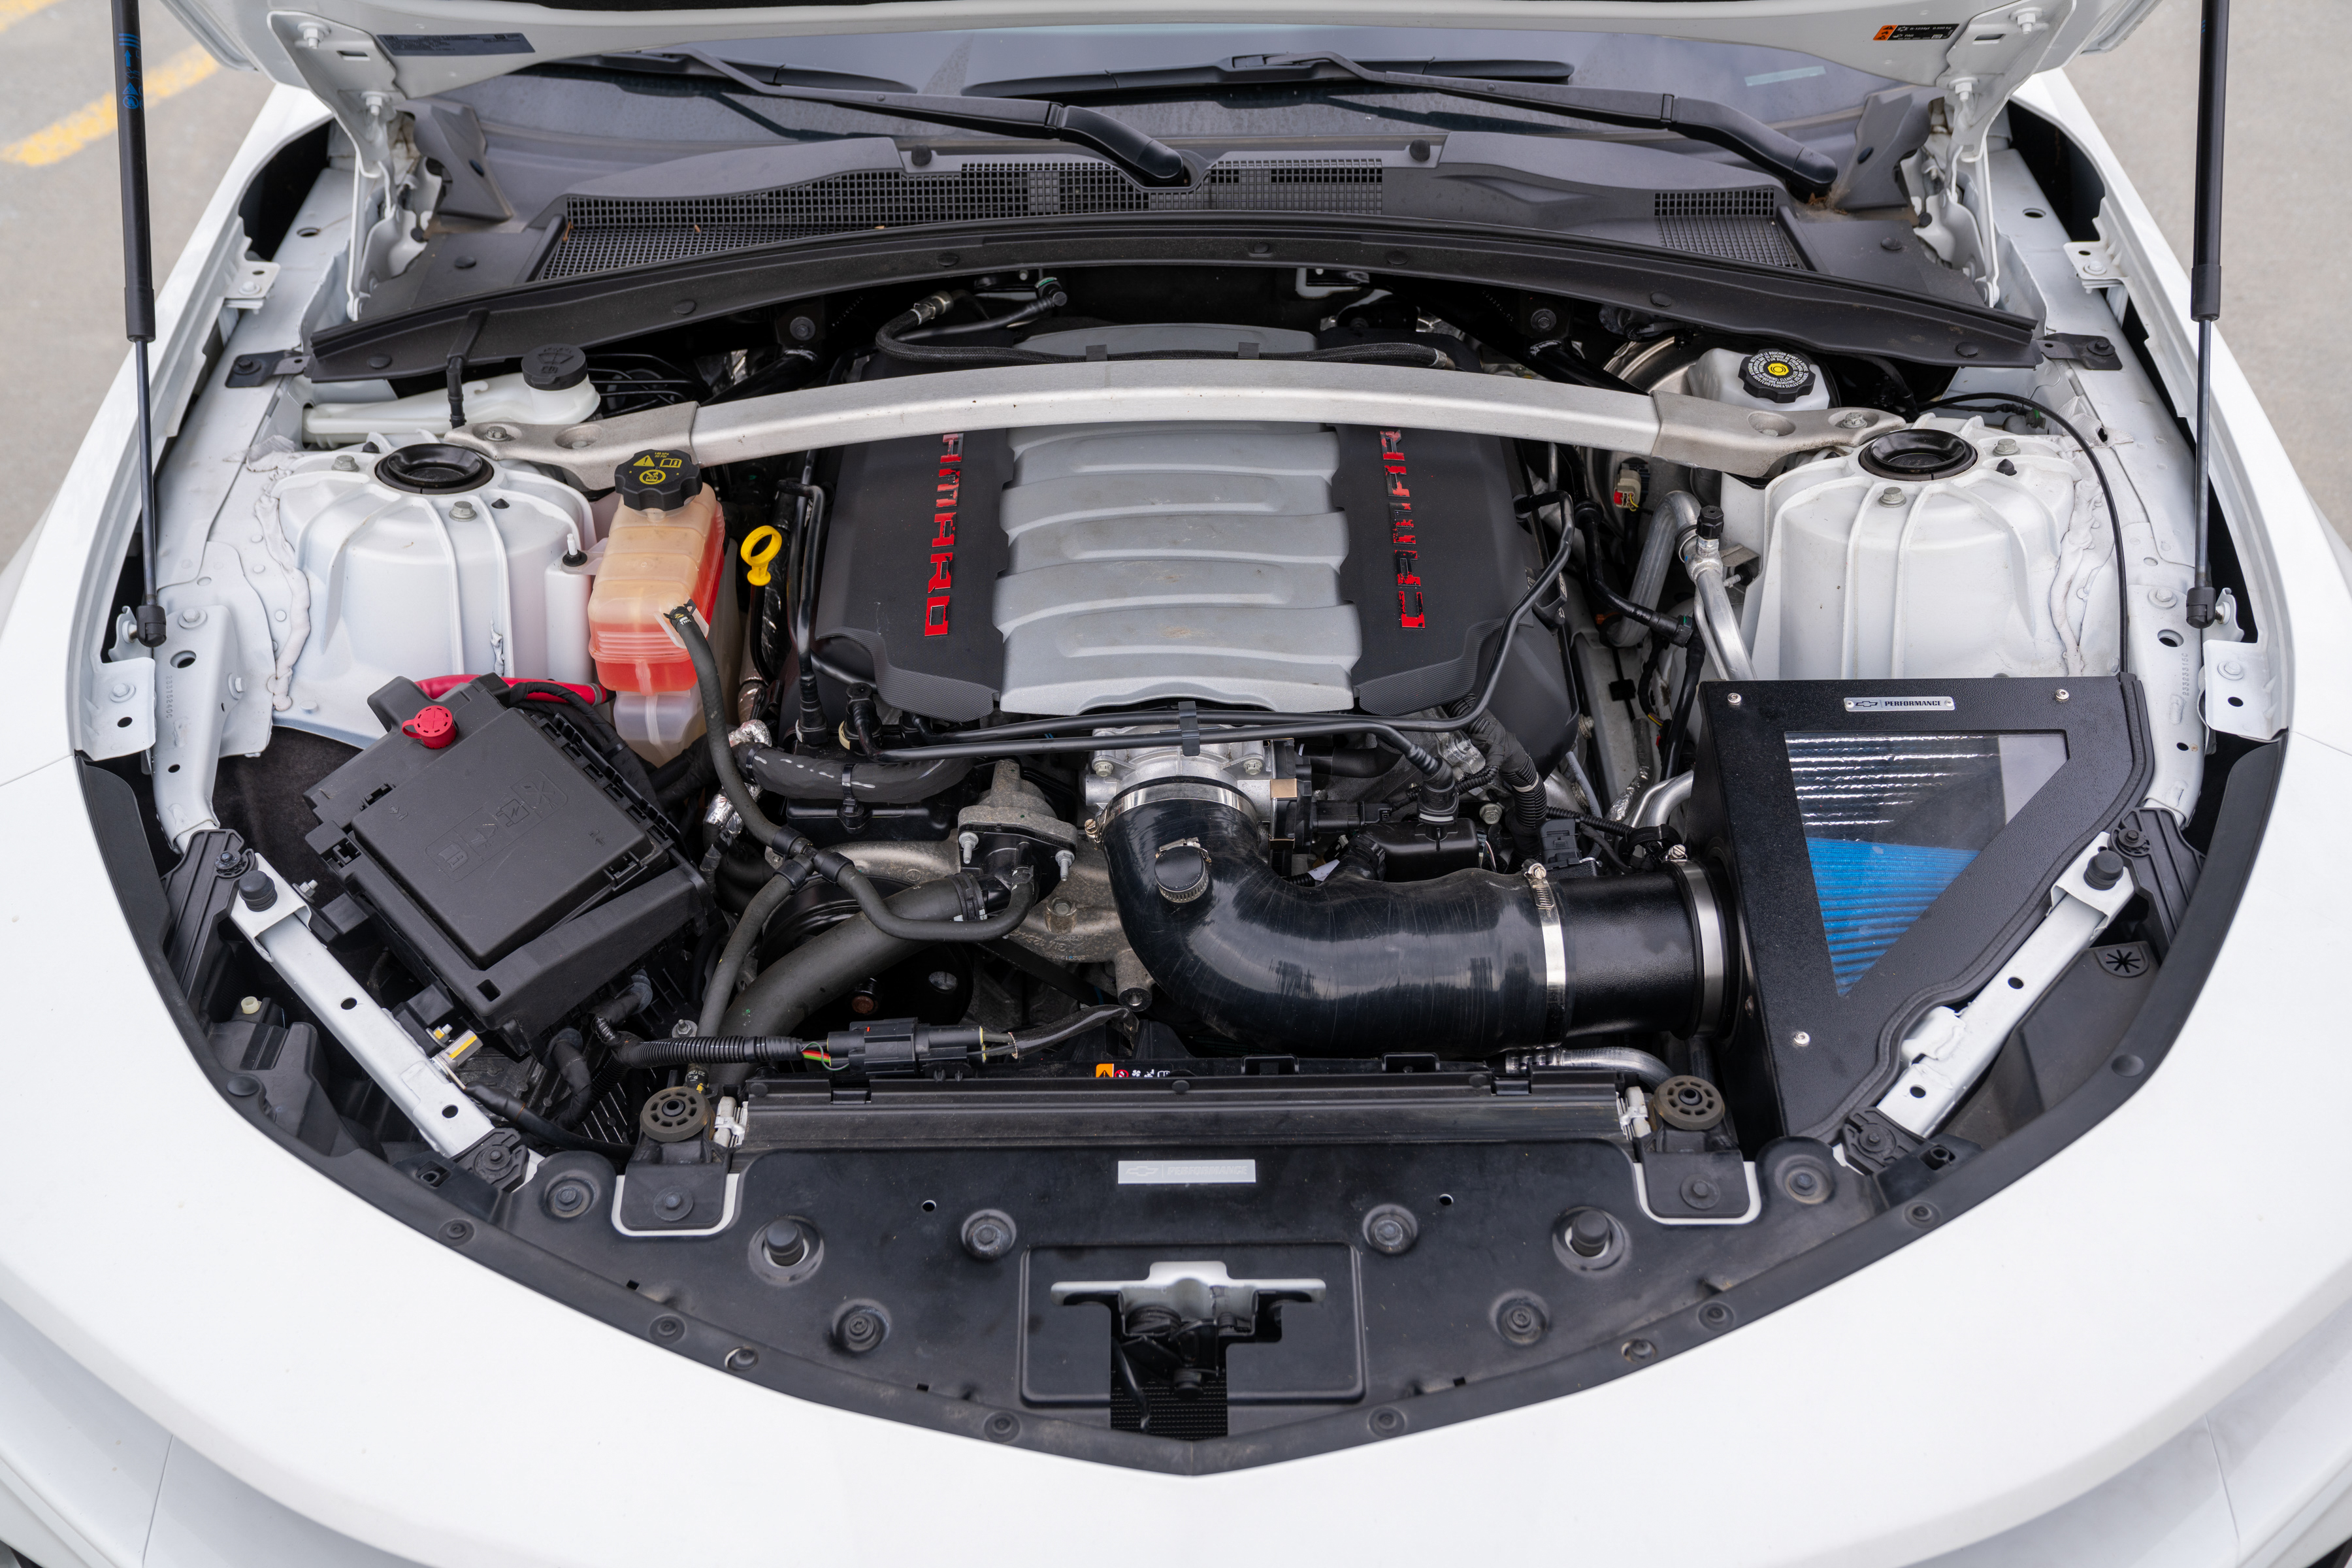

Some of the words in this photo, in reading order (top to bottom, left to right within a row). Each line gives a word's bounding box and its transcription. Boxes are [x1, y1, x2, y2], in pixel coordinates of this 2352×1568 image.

[924, 433, 964, 636] AMARO
[1380, 430, 1425, 628] CAMAR
[1167, 1165, 1248, 1175] PERFORMANCE
